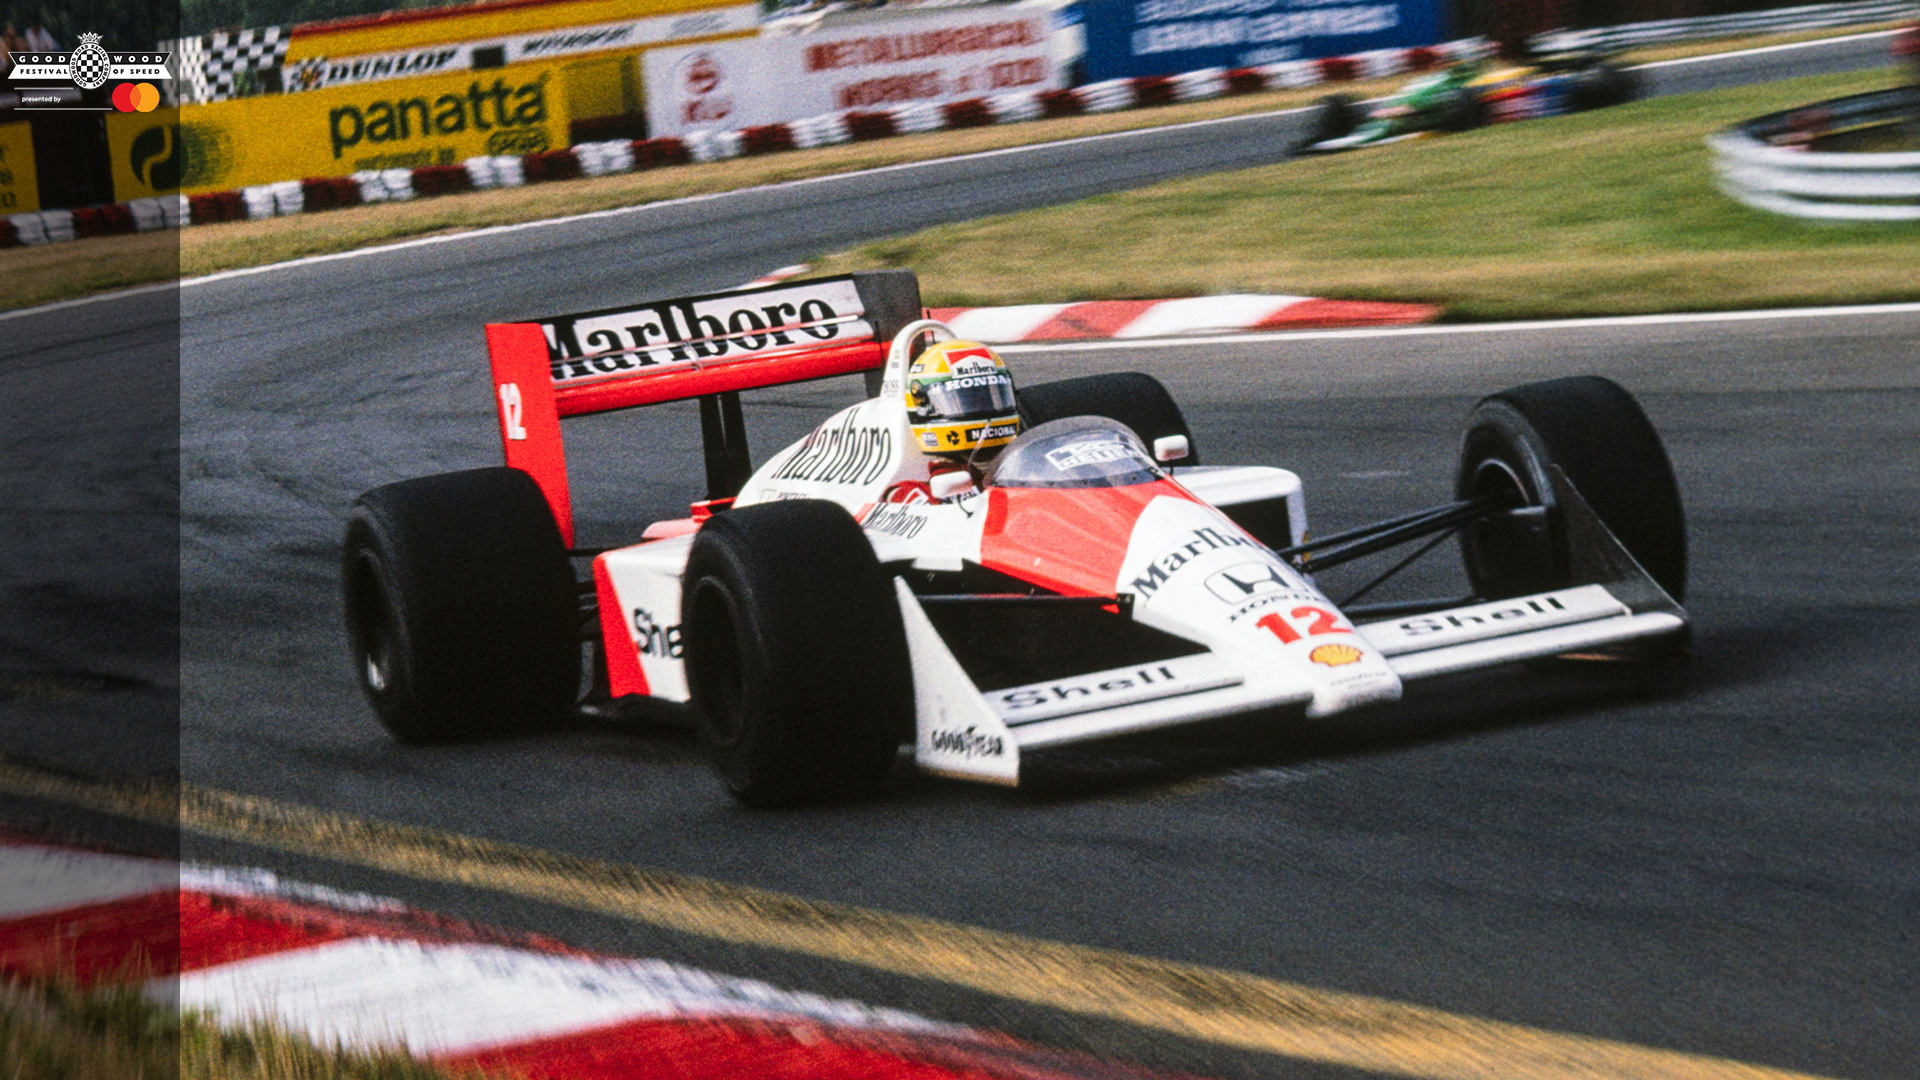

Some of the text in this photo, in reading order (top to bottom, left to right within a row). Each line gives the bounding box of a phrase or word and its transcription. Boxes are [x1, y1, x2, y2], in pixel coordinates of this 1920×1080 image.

[328, 49, 458, 81] DUNLOP
[329, 71, 550, 161] panatta
[550, 297, 841, 381] Marlboro
[944, 374, 1008, 392] HONDA
[957, 361, 996, 376] Marlboro
[499, 382, 527, 441] 12
[971, 424, 1016, 440] NACIONAL
[770, 406, 891, 486] Marlboro
[863, 502, 928, 539] Marlboro
[1129, 526, 1266, 600] Marlb
[634, 607, 684, 659] She
[1255, 605, 1354, 645] 12
[1399, 597, 1566, 636] Shell
[1000, 666, 1176, 710] Shell
